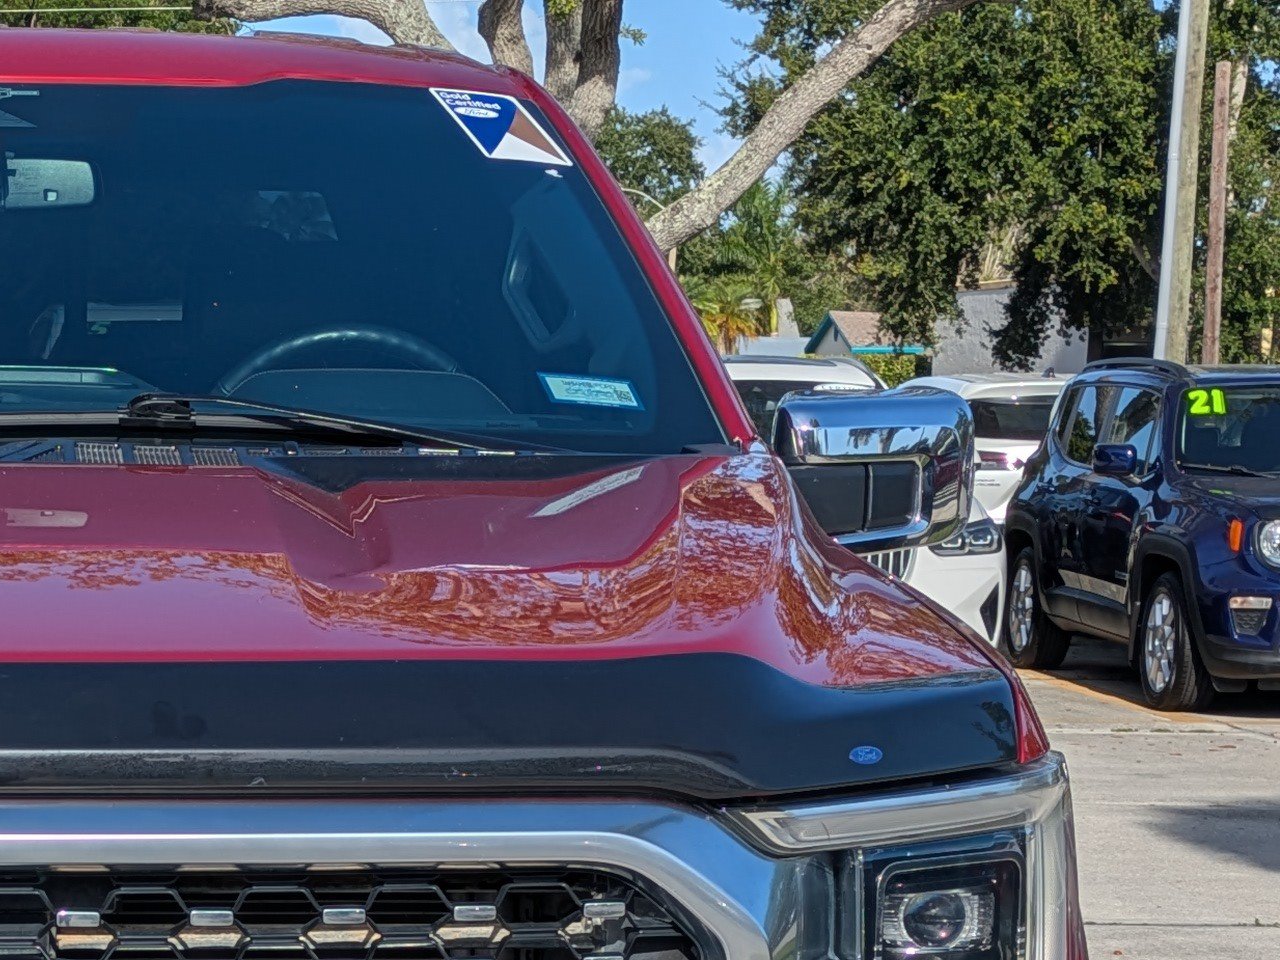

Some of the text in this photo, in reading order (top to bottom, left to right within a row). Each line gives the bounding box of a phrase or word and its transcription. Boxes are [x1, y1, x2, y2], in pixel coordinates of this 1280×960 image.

[439, 92, 471, 100] Gold
[445, 99, 501, 110] Certified
[1188, 389, 1227, 414] 21
